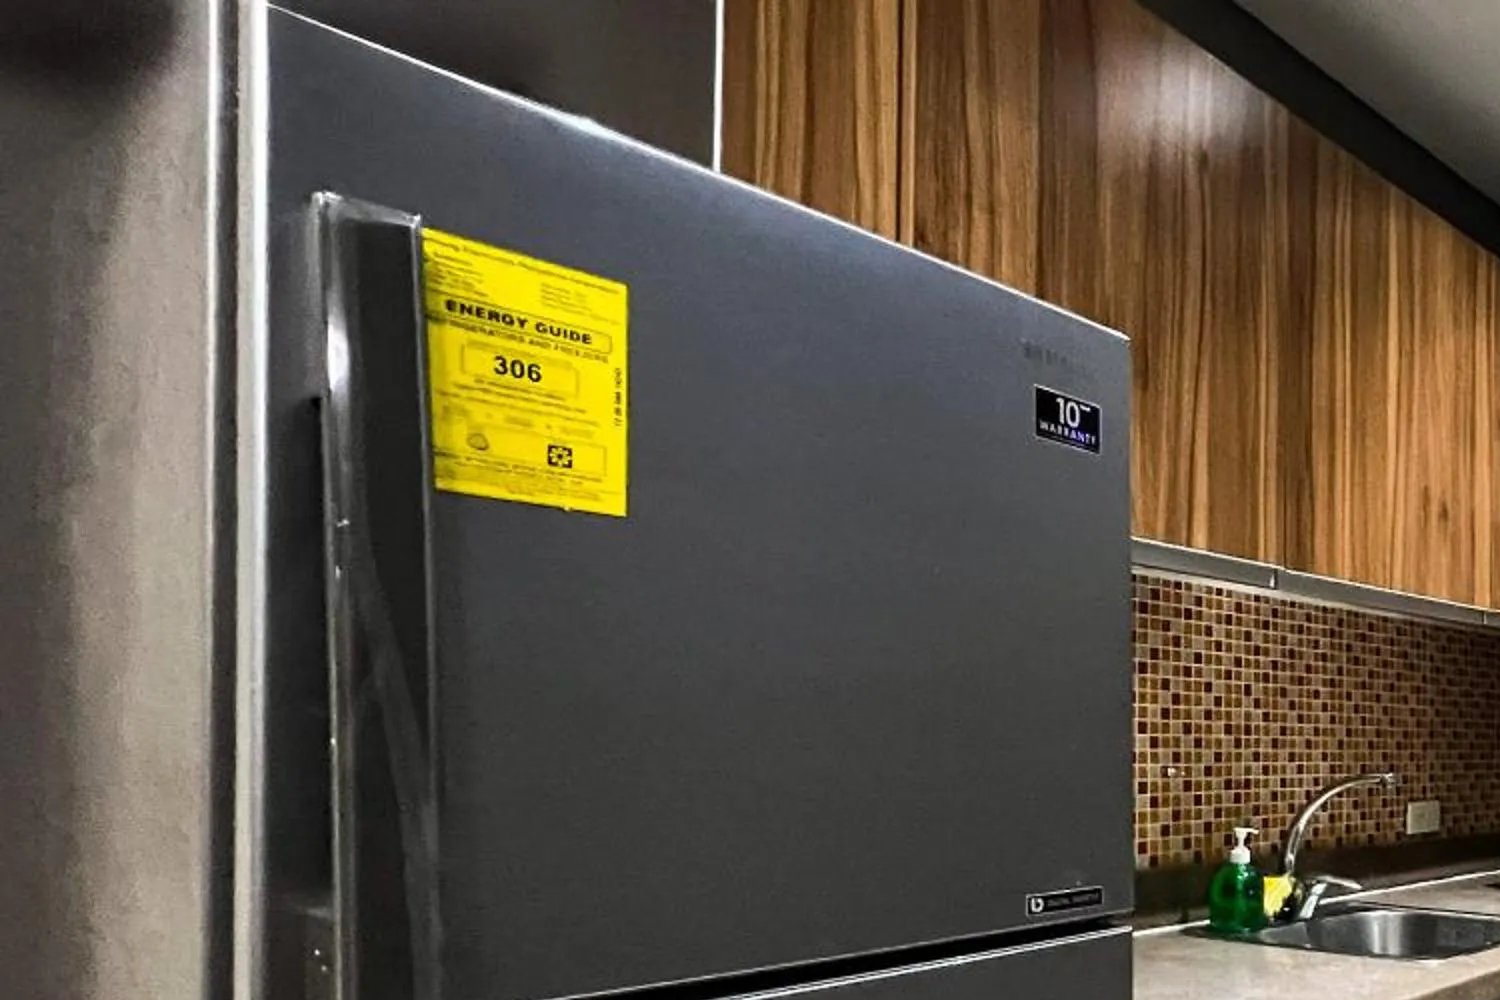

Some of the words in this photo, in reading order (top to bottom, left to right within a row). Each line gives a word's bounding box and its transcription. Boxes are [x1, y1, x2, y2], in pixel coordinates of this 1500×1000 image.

[446, 299, 529, 329] ENERGY
[535, 321, 592, 345] GUIDE
[493, 355, 542, 383] 306
[1056, 397, 1080, 428] 10
